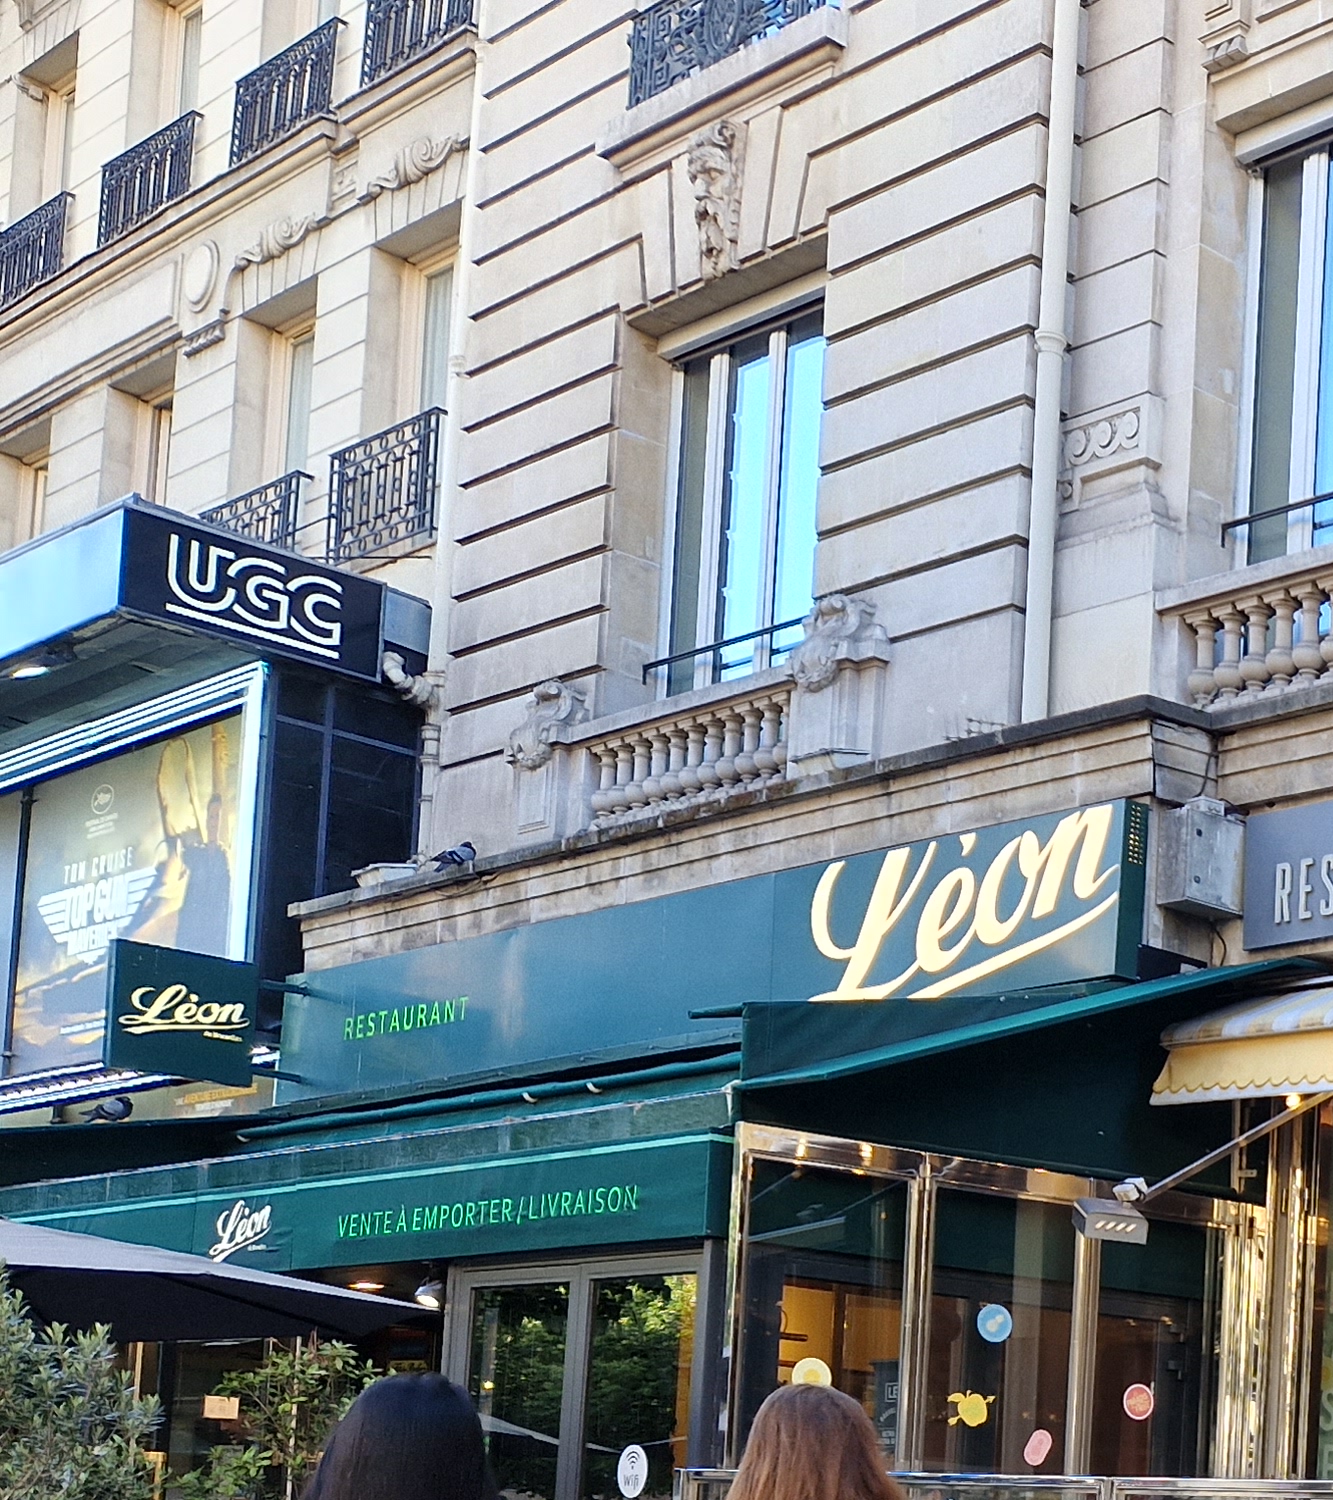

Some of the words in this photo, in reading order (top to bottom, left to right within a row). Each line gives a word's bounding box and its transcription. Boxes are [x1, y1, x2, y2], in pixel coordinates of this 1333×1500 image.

[166, 533, 343, 648] UGC
[64, 860, 86, 885] TOM
[91, 846, 134, 878] CRUISE
[63, 883, 95, 931] TOP
[808, 802, 1120, 1002] Léon
[344, 995, 469, 1041] RESTAURANT
[338, 1209, 393, 1239] VENTE
[623, 1474, 639, 1490] Wifi
